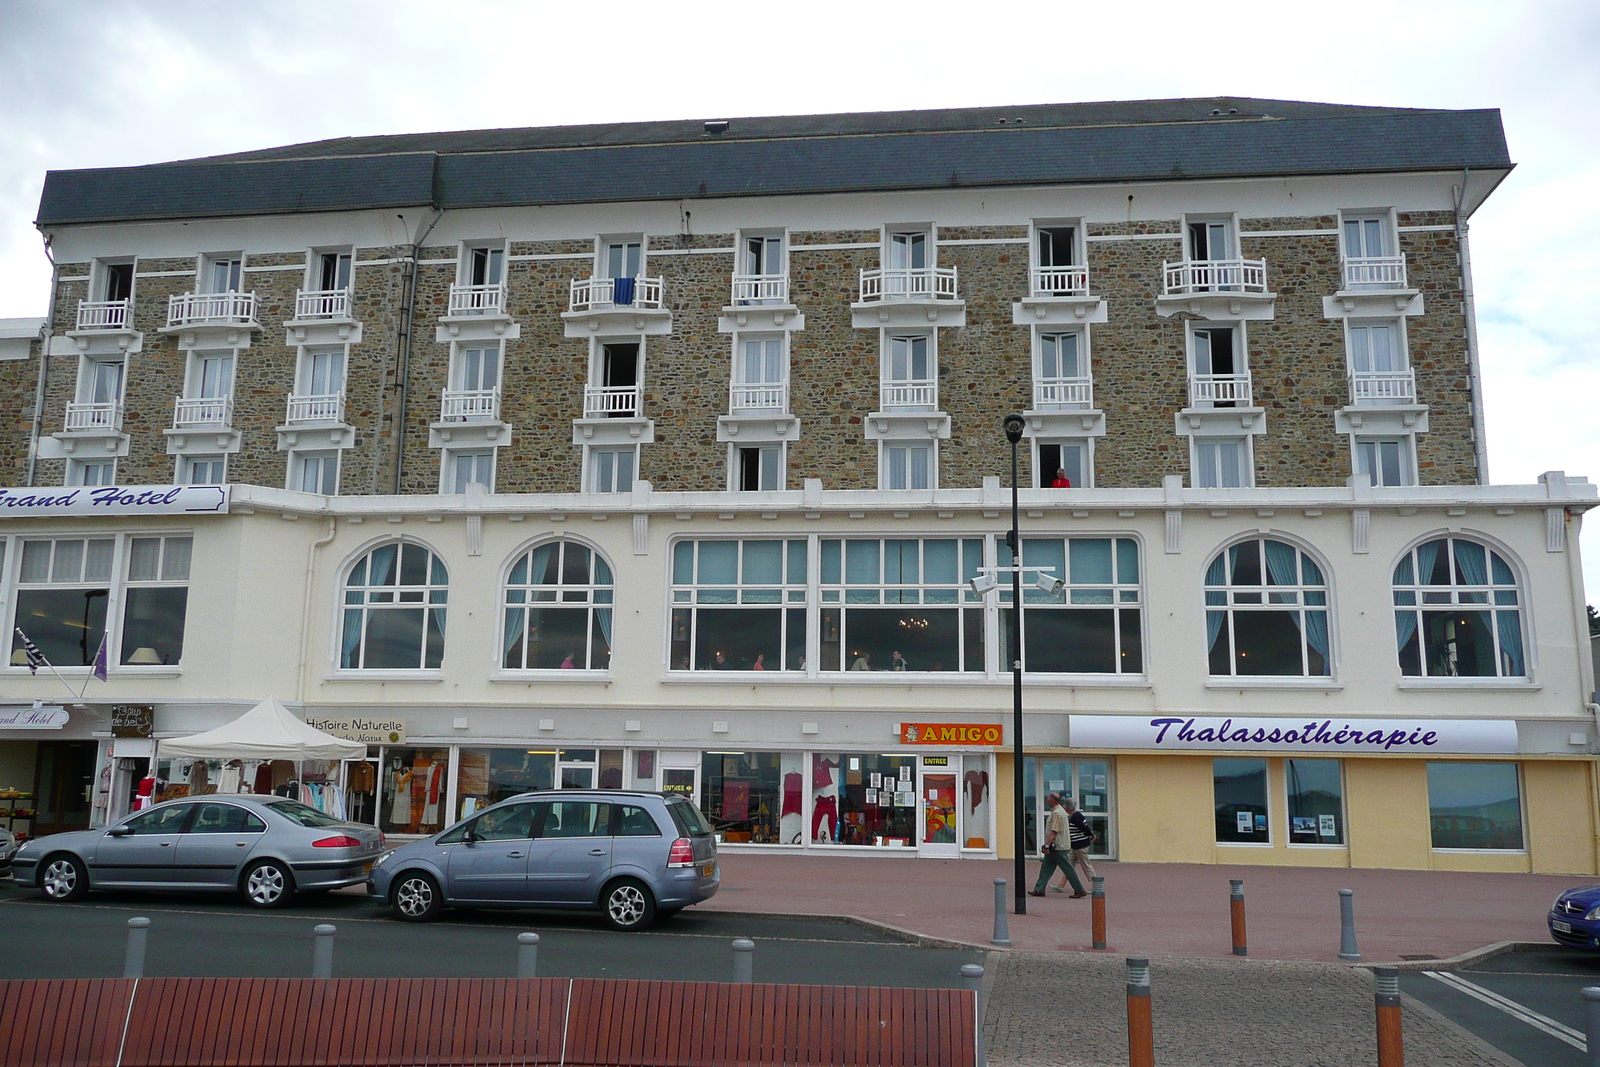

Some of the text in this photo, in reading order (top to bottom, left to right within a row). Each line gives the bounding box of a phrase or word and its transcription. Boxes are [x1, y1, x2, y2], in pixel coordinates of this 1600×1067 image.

[90, 487, 182, 506] Hotel
[352, 718, 402, 730] Naturelle
[922, 726, 999, 742] AMIGO
[1150, 717, 1438, 750] Thalassothérapie
